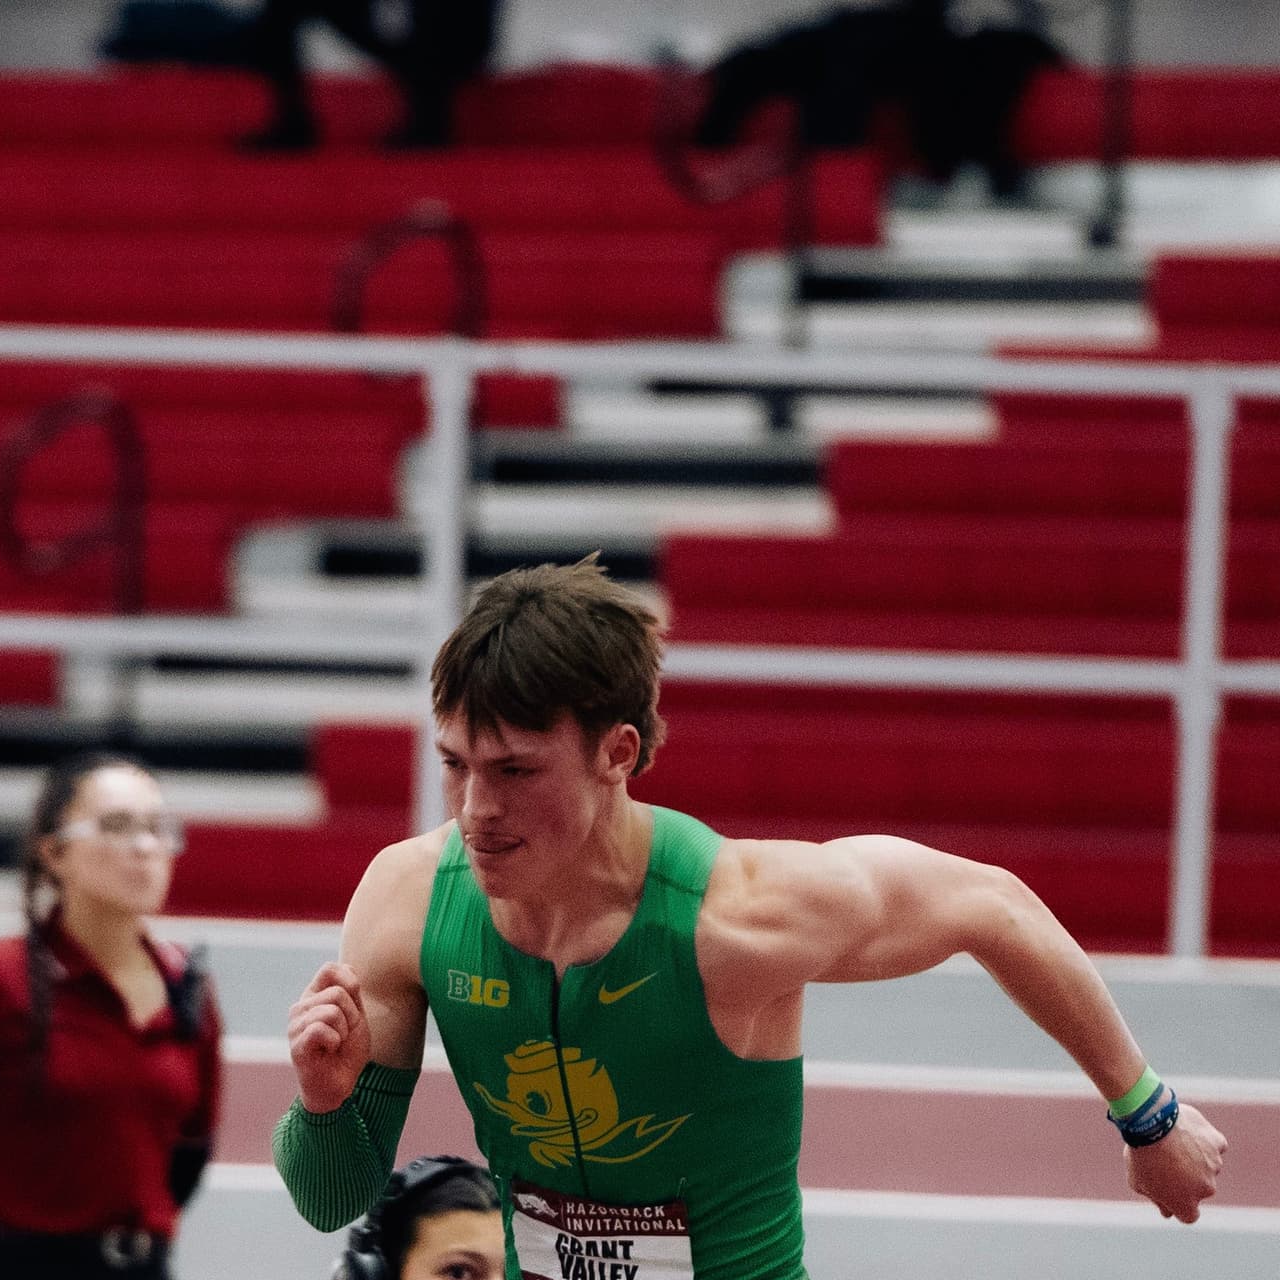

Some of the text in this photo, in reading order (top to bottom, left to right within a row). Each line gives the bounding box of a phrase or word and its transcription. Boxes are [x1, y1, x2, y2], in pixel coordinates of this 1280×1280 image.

[566, 1202, 665, 1218] RAZORBACK
[566, 1216, 686, 1231] INVITATIONAL
[555, 1232, 634, 1260] GRANT
